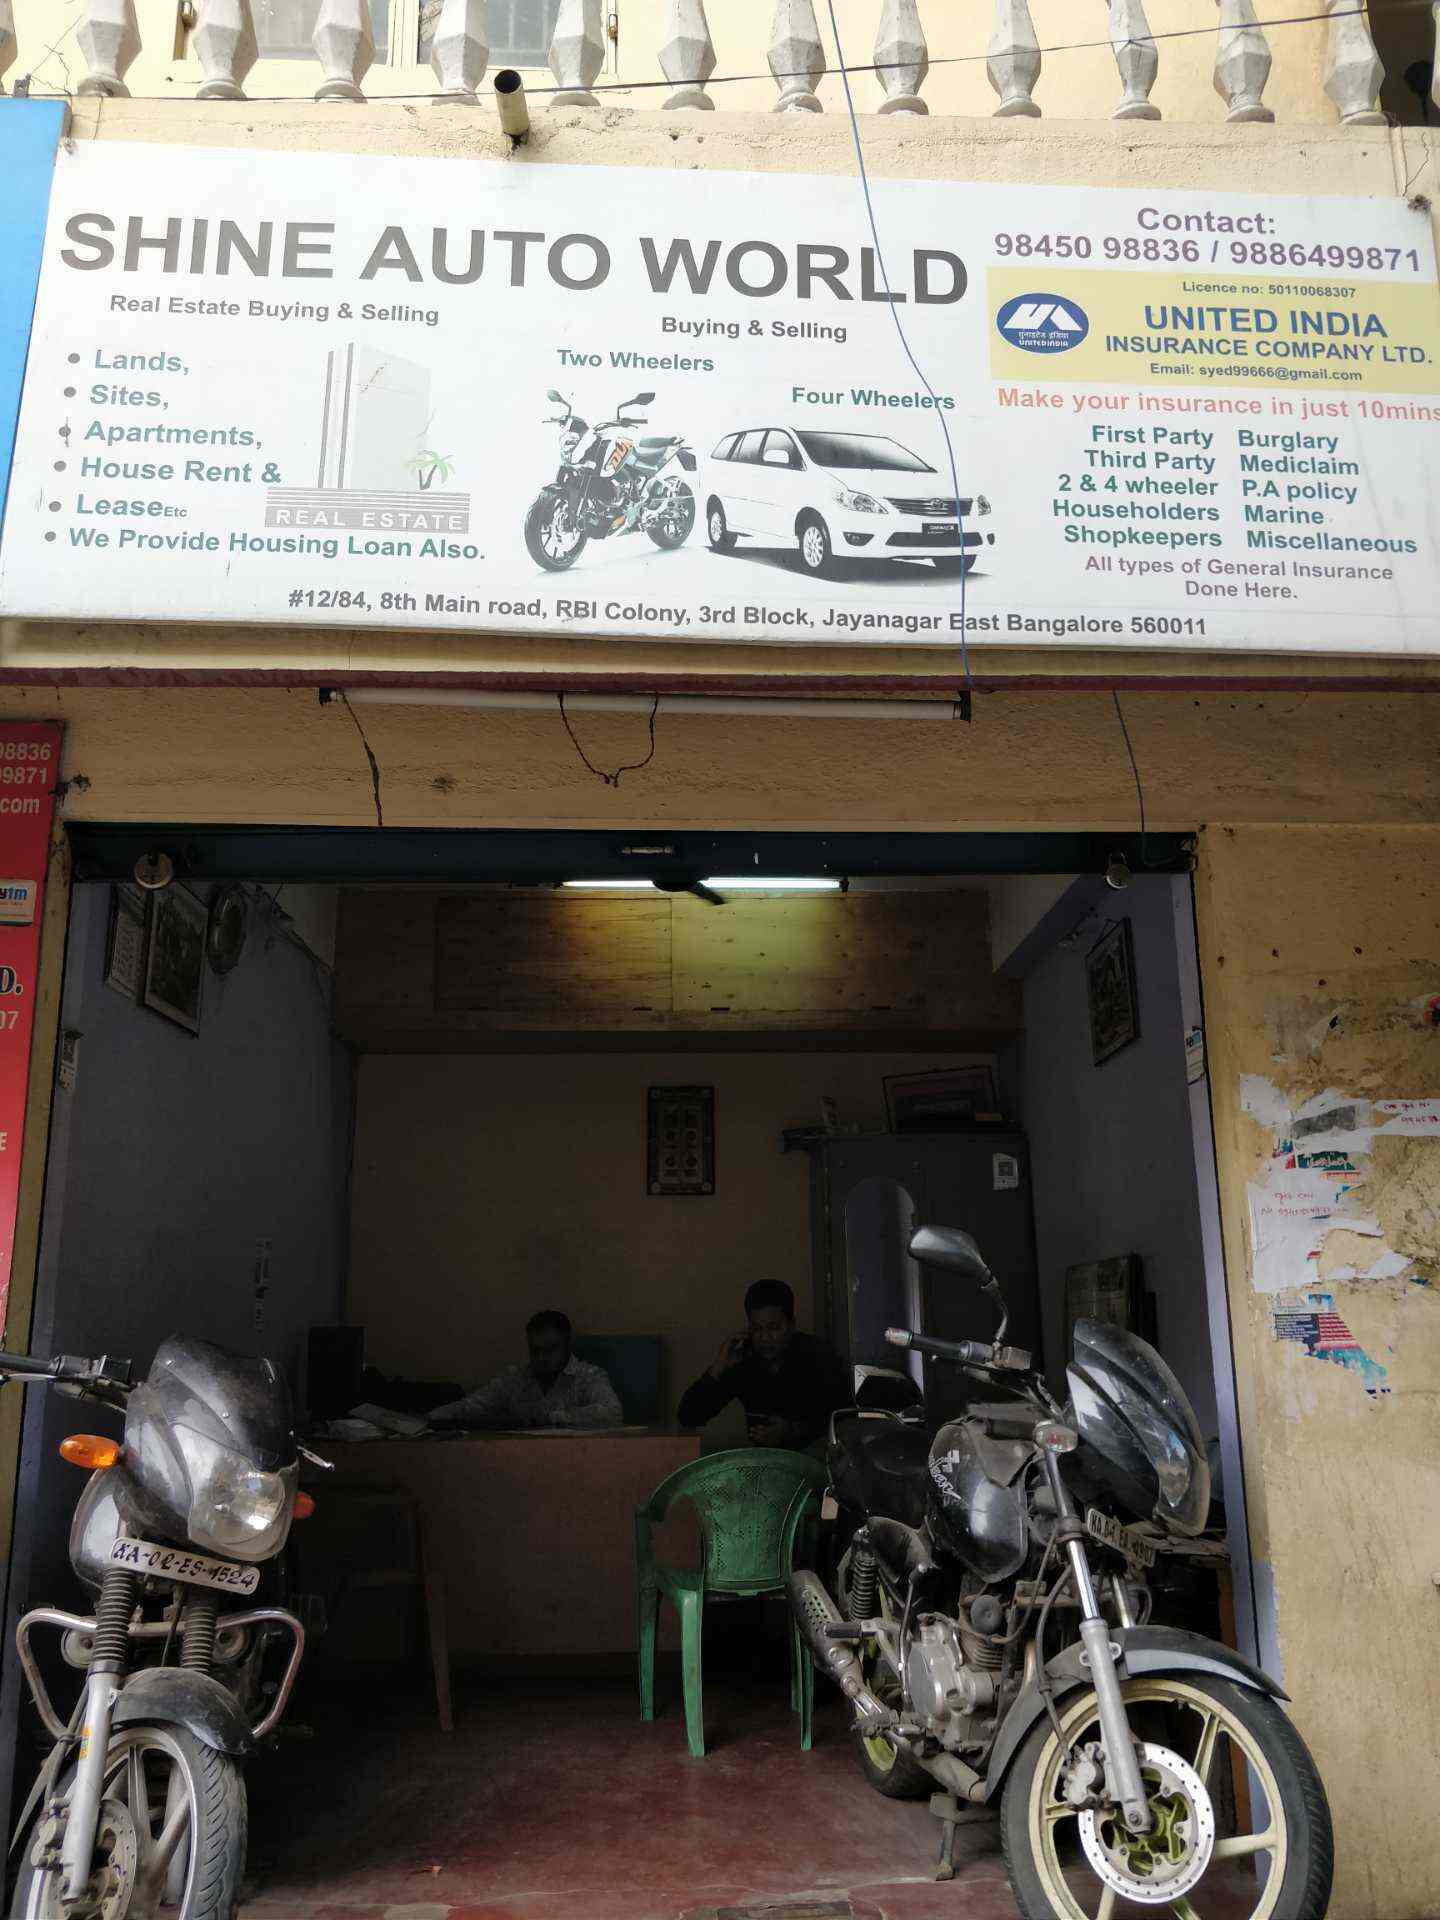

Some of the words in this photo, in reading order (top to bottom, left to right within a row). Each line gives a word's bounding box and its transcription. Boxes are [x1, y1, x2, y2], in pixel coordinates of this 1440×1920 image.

[1138, 208, 1275, 234] Contact:
[61, 213, 335, 278] SHINE
[359, 226, 610, 290] AUTO
[640, 237, 967, 305] WORLD
[995, 233, 1091, 258] 98450
[1103, 237, 1199, 262] 98836
[1211, 240, 1219, 263] /
[1230, 242, 1419, 271] 9886499871
[1183, 281, 1237, 293] Licence
[1242, 286, 1263, 294] no:
[1269, 285, 1356, 298] 50110068307
[111, 295, 160, 312] Real
[169, 297, 240, 315] Estate
[249, 301, 329, 322] Buying
[338, 303, 353, 319] &
[361, 304, 438, 326] Selling
[1145, 306, 1277, 333] UNITED
[1290, 311, 1388, 337] INDIA
[662, 317, 739, 339] Buying
[748, 320, 763, 336] &
[772, 321, 846, 343] Selling
[557, 349, 602, 367] Two
[610, 352, 714, 371] Wheelers
[1107, 336, 1248, 356] INSURANCE
[1256, 341, 1374, 361] COMPANY
[1383, 346, 1432, 363] LTD.
[95, 349, 189, 375] Lands,
[1151, 363, 1194, 374] Email:
[1199, 365, 1362, 381] syed99666@gmail.com
[90, 385, 168, 410] Sites,
[793, 387, 844, 404] Four
[851, 389, 955, 411] Wheelers
[998, 388, 1063, 409] Make
[1073, 395, 1129, 413] your
[1139, 392, 1261, 414] insurance
[1272, 397, 1293, 415] in
[1301, 398, 1349, 420] just
[84, 421, 261, 449] Apartments,
[1093, 425, 1145, 443] First
[1153, 427, 1213, 449] Party
[1238, 430, 1338, 454] Burglary
[81, 457, 174, 480] House
[185, 461, 252, 482] Rent
[261, 463, 281, 483] &
[1084, 450, 1146, 468] Third
[1155, 452, 1215, 474] Party
[1240, 455, 1359, 475] Mediclaim
[1059, 474, 1071, 491] 2
[1080, 474, 1097, 491] &
[1104, 476, 1118, 492] 4
[1125, 476, 1218, 495] wheeler
[1243, 480, 1280, 497] P.A
[1287, 482, 1357, 504] policy
[77, 494, 163, 516] Lease
[164, 507, 187, 517] Etc
[1053, 499, 1219, 521] Householders
[1245, 505, 1324, 524] Marine
[277, 510, 345, 526] REAL
[361, 513, 464, 531] ESTATE
[70, 528, 109, 547] We
[119, 529, 219, 550] Provide
[230, 533, 338, 558] Housing
[348, 536, 411, 556] Loan
[419, 539, 484, 559] Also.
[1064, 525, 1222, 549] Shopkeepers
[1247, 530, 1417, 553] Miscellaneous
[1085, 556, 1112, 571] All
[1118, 558, 1174, 575] types
[1181, 559, 1202, 573] of
[1208, 559, 1285, 576] General
[1293, 562, 1393, 579] Insurance
[1186, 581, 1238, 597] Done
[1245, 582, 1297, 598] Here.
[289, 590, 371, 612] #12/84,
[381, 592, 416, 611] 8th
[426, 594, 479, 613] Main
[489, 599, 547, 619] road,
[557, 600, 596, 619] RBI
[605, 603, 690, 626] Colony,
[699, 606, 735, 623] 3rd
[744, 607, 814, 628] Block,
[823, 609, 942, 633] Jayanagar
[950, 612, 1000, 634] East
[1007, 614, 1123, 636] Bangalore
[1131, 617, 1205, 635] 560011
